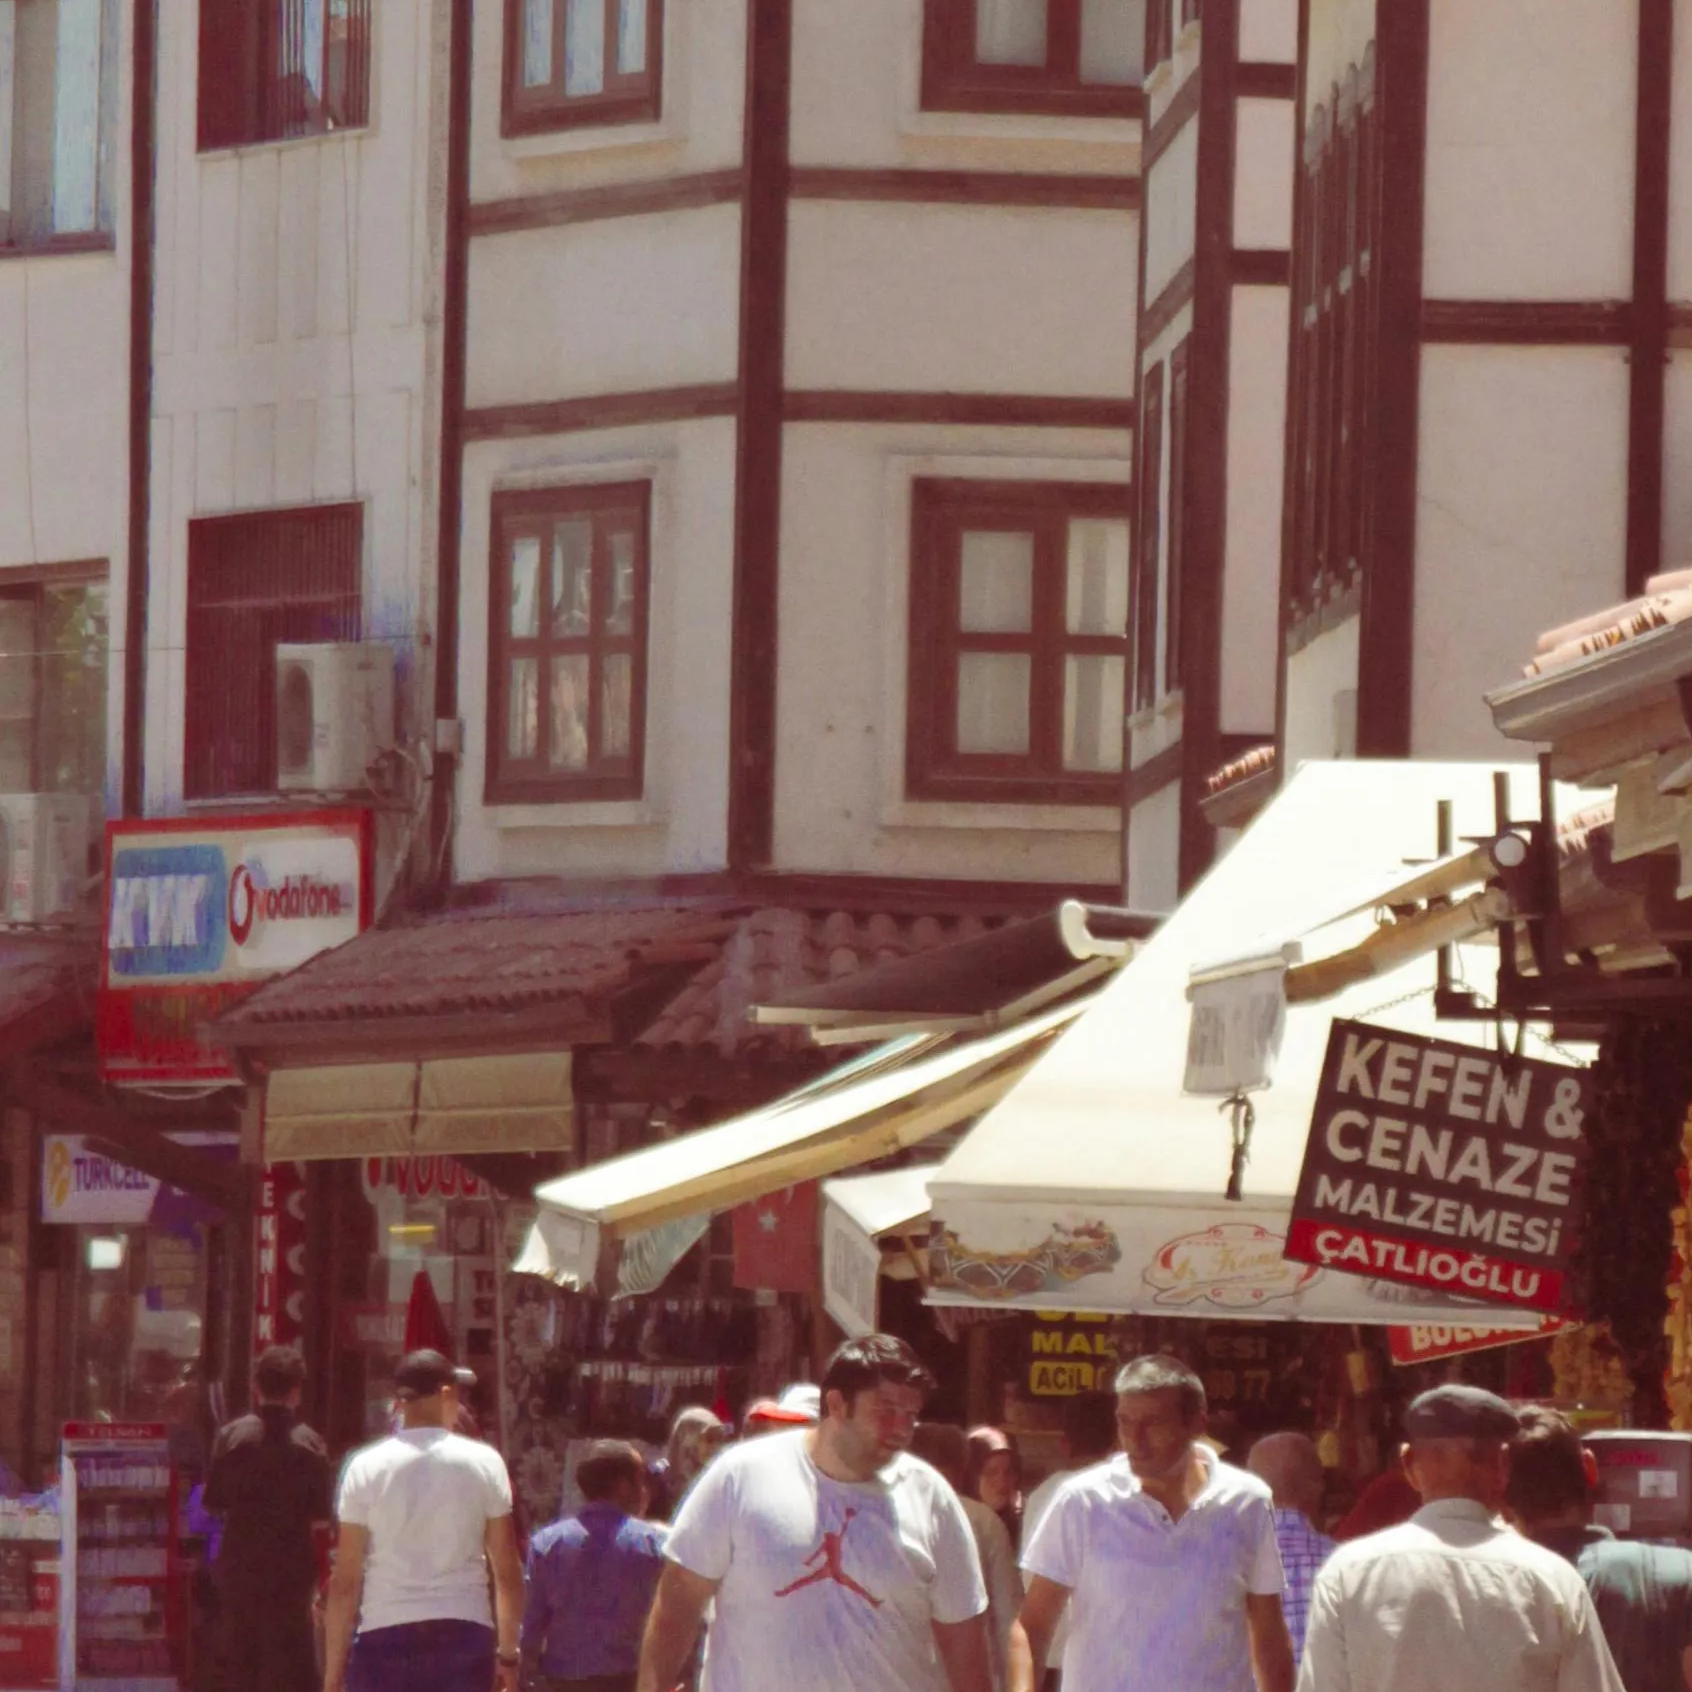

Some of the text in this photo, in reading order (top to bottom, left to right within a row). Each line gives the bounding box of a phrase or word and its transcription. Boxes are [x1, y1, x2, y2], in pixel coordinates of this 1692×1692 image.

[252, 874, 341, 921] vodafone
[1336, 1034, 1585, 1139] KEFEN &
[1326, 1110, 1577, 1206] CENAZE
[1314, 1174, 1563, 1256] MALZEMESİ
[1315, 1229, 1541, 1298] ÇATLIOĞLU
